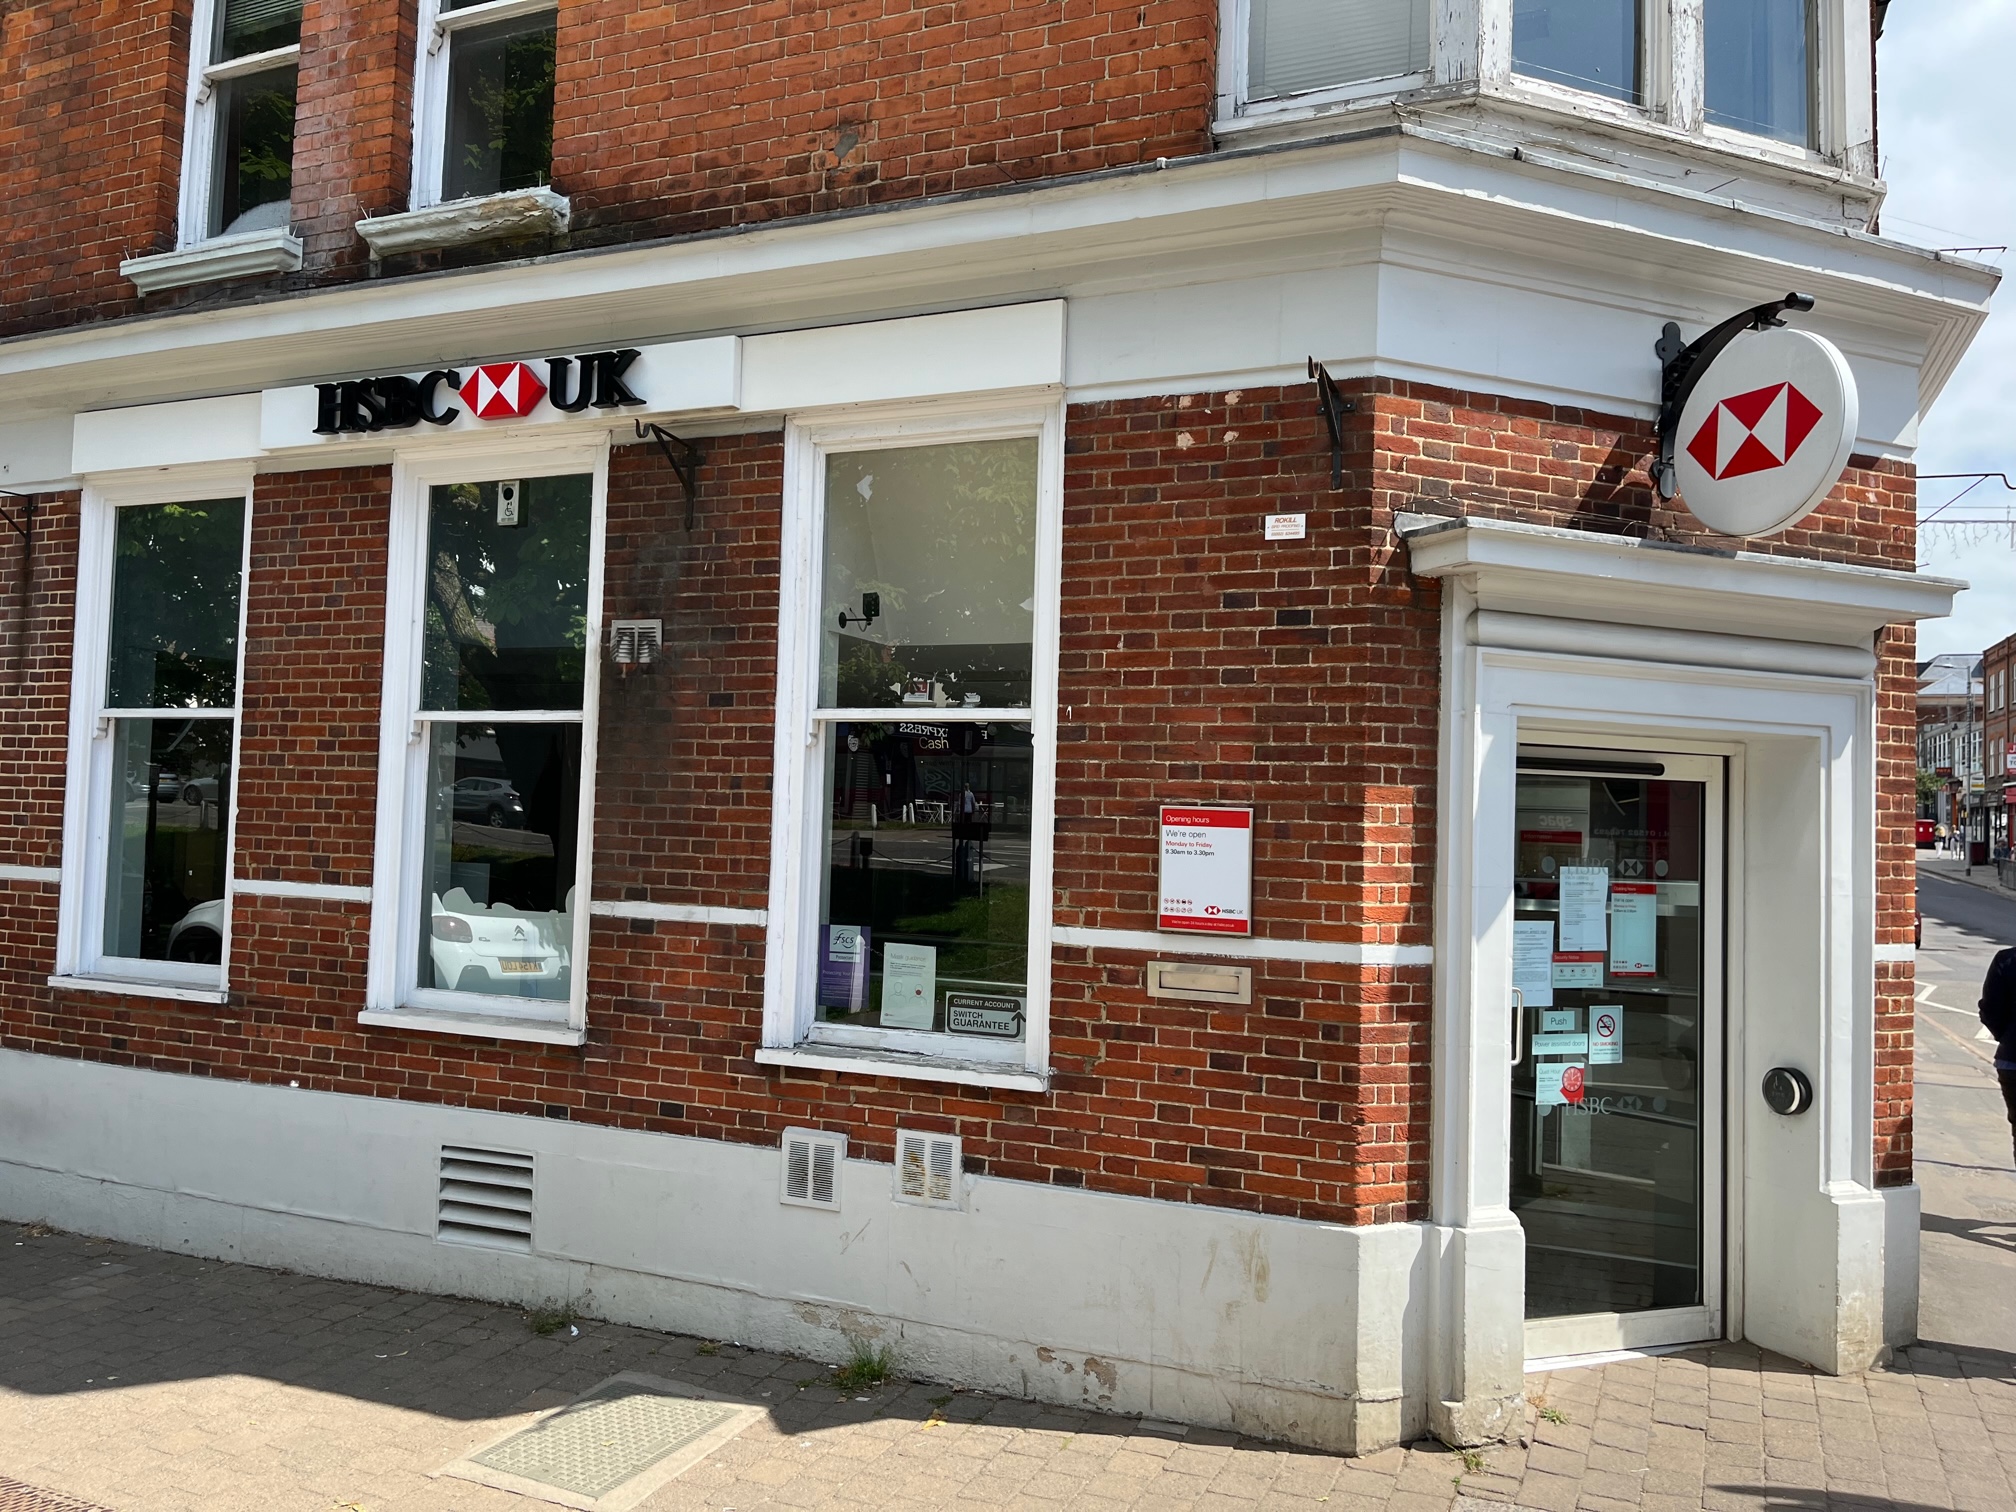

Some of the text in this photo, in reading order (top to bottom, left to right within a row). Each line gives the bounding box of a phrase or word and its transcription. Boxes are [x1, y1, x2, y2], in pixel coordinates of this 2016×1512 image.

[313, 348, 647, 435] HSBC UK
[919, 736, 949, 749] Cash
[1165, 815, 1210, 824] Opening hours
[1188, 831, 1206, 839] open
[1165, 840, 1187, 848] Monday
[1195, 841, 1212, 849] Friday
[1193, 849, 1215, 857] 3.30pm
[1567, 857, 1615, 876] HSBC
[904, 954, 927, 962] guidance
[953, 998, 1015, 1009] CURRENT ACCOUNT
[953, 1010, 983, 1019] SWITCH
[953, 1018, 1010, 1031] GUARANTEE
[1550, 1017, 1567, 1026] Push
[1565, 1096, 1613, 1116] HSBC
